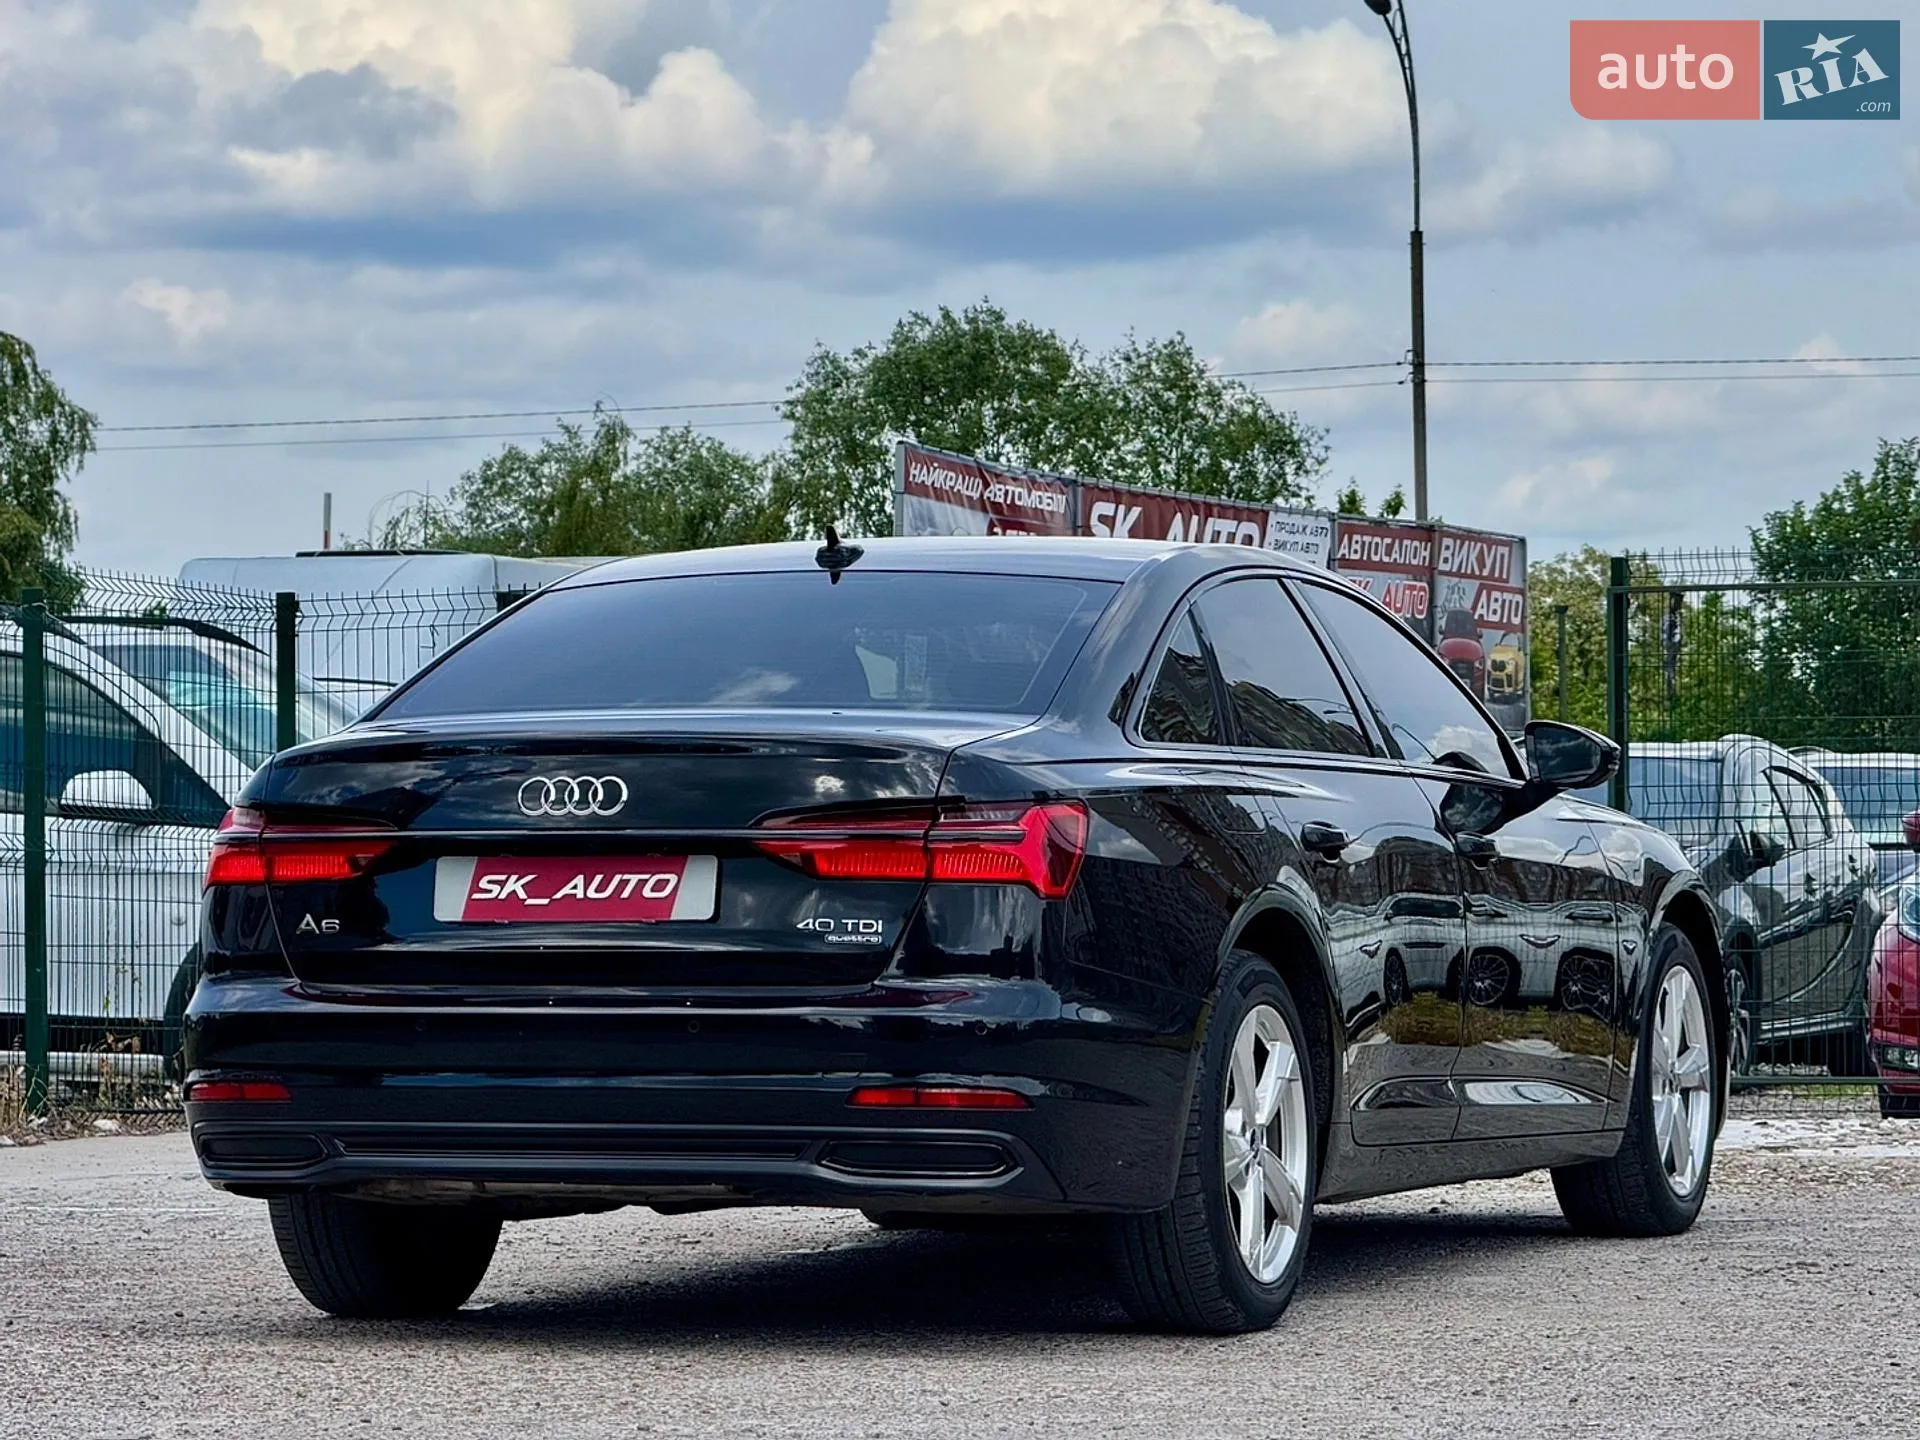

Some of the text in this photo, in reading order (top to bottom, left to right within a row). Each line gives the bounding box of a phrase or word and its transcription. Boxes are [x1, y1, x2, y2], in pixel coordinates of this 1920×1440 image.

[909, 462, 982, 500] НАЙКРАЩІ
[1336, 533, 1432, 566] АВТОСАЛОН
[1438, 537, 1510, 579] ВИКУП
[1382, 580, 1429, 619] AUTO
[1474, 589, 1524, 625] АВТО
[471, 873, 679, 906] SK_AUTO
[295, 913, 340, 934] A6
[796, 918, 883, 933] 40 TDI
